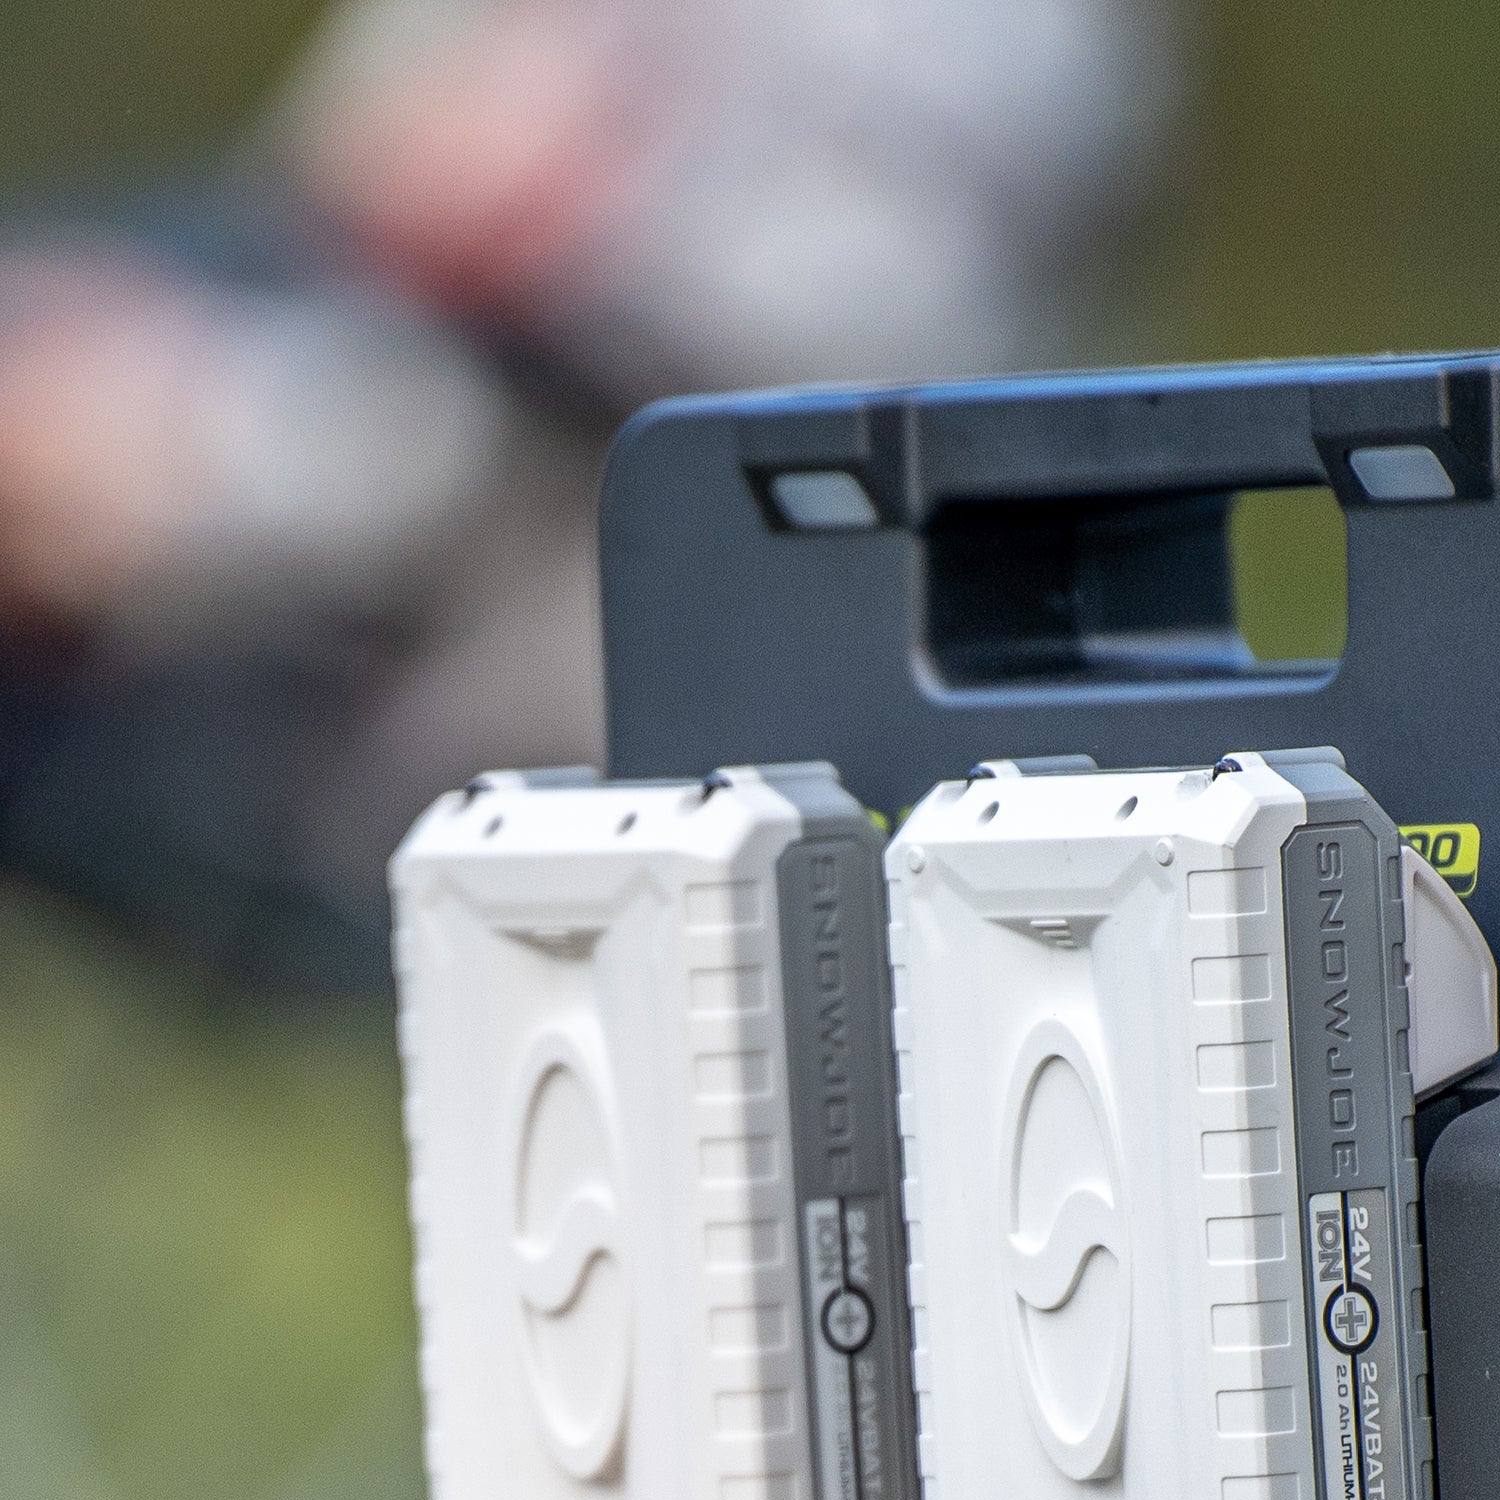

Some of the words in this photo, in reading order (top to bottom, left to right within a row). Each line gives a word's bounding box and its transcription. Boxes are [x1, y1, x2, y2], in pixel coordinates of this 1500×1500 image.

[811, 854, 856, 1187] SNOWJOE
[1316, 841, 1359, 1177] SNOWJOE
[1315, 1210, 1344, 1282] ION
[1350, 1207, 1373, 1281] 24V
[1336, 1364, 1349, 1397] 2.0
[1338, 1404, 1350, 1431] Ah
